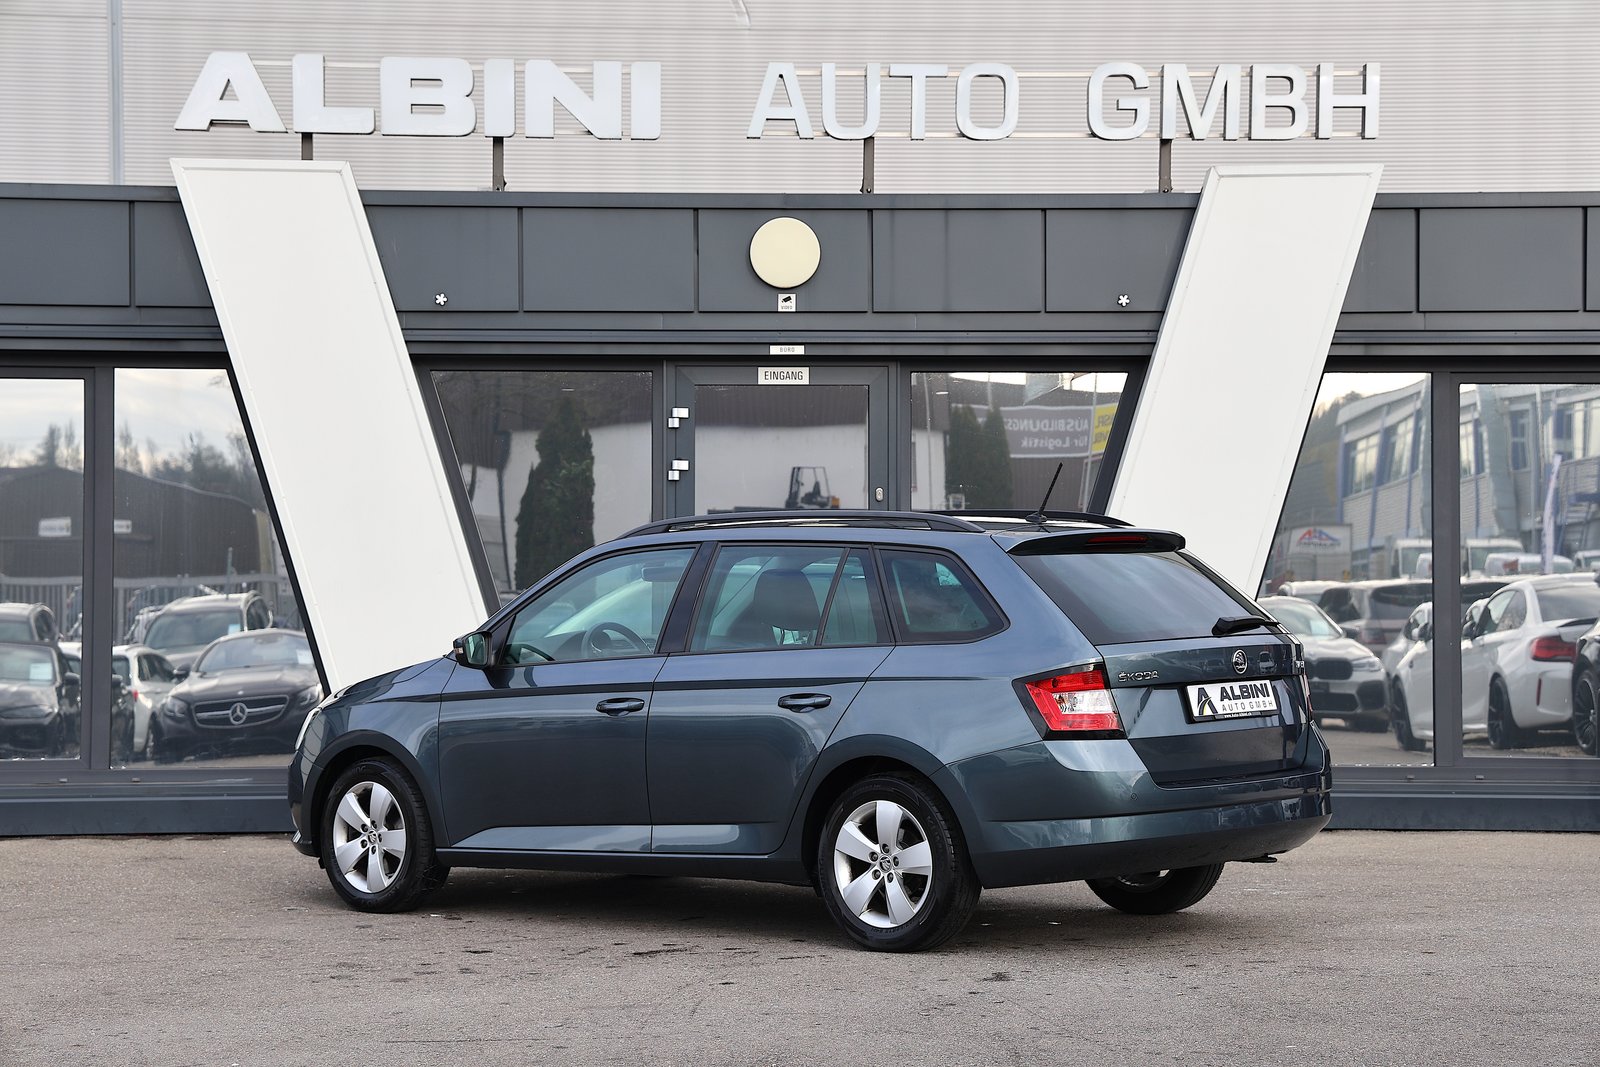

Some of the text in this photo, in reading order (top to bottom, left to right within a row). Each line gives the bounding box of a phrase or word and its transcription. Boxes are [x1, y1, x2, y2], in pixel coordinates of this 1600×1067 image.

[174, 51, 1381, 140] ALBINI AUTO GMBH
[764, 371, 803, 380] EINGANG
[1220, 682, 1270, 702] ALBINI
[1222, 700, 1274, 712] AUTO GMBH
